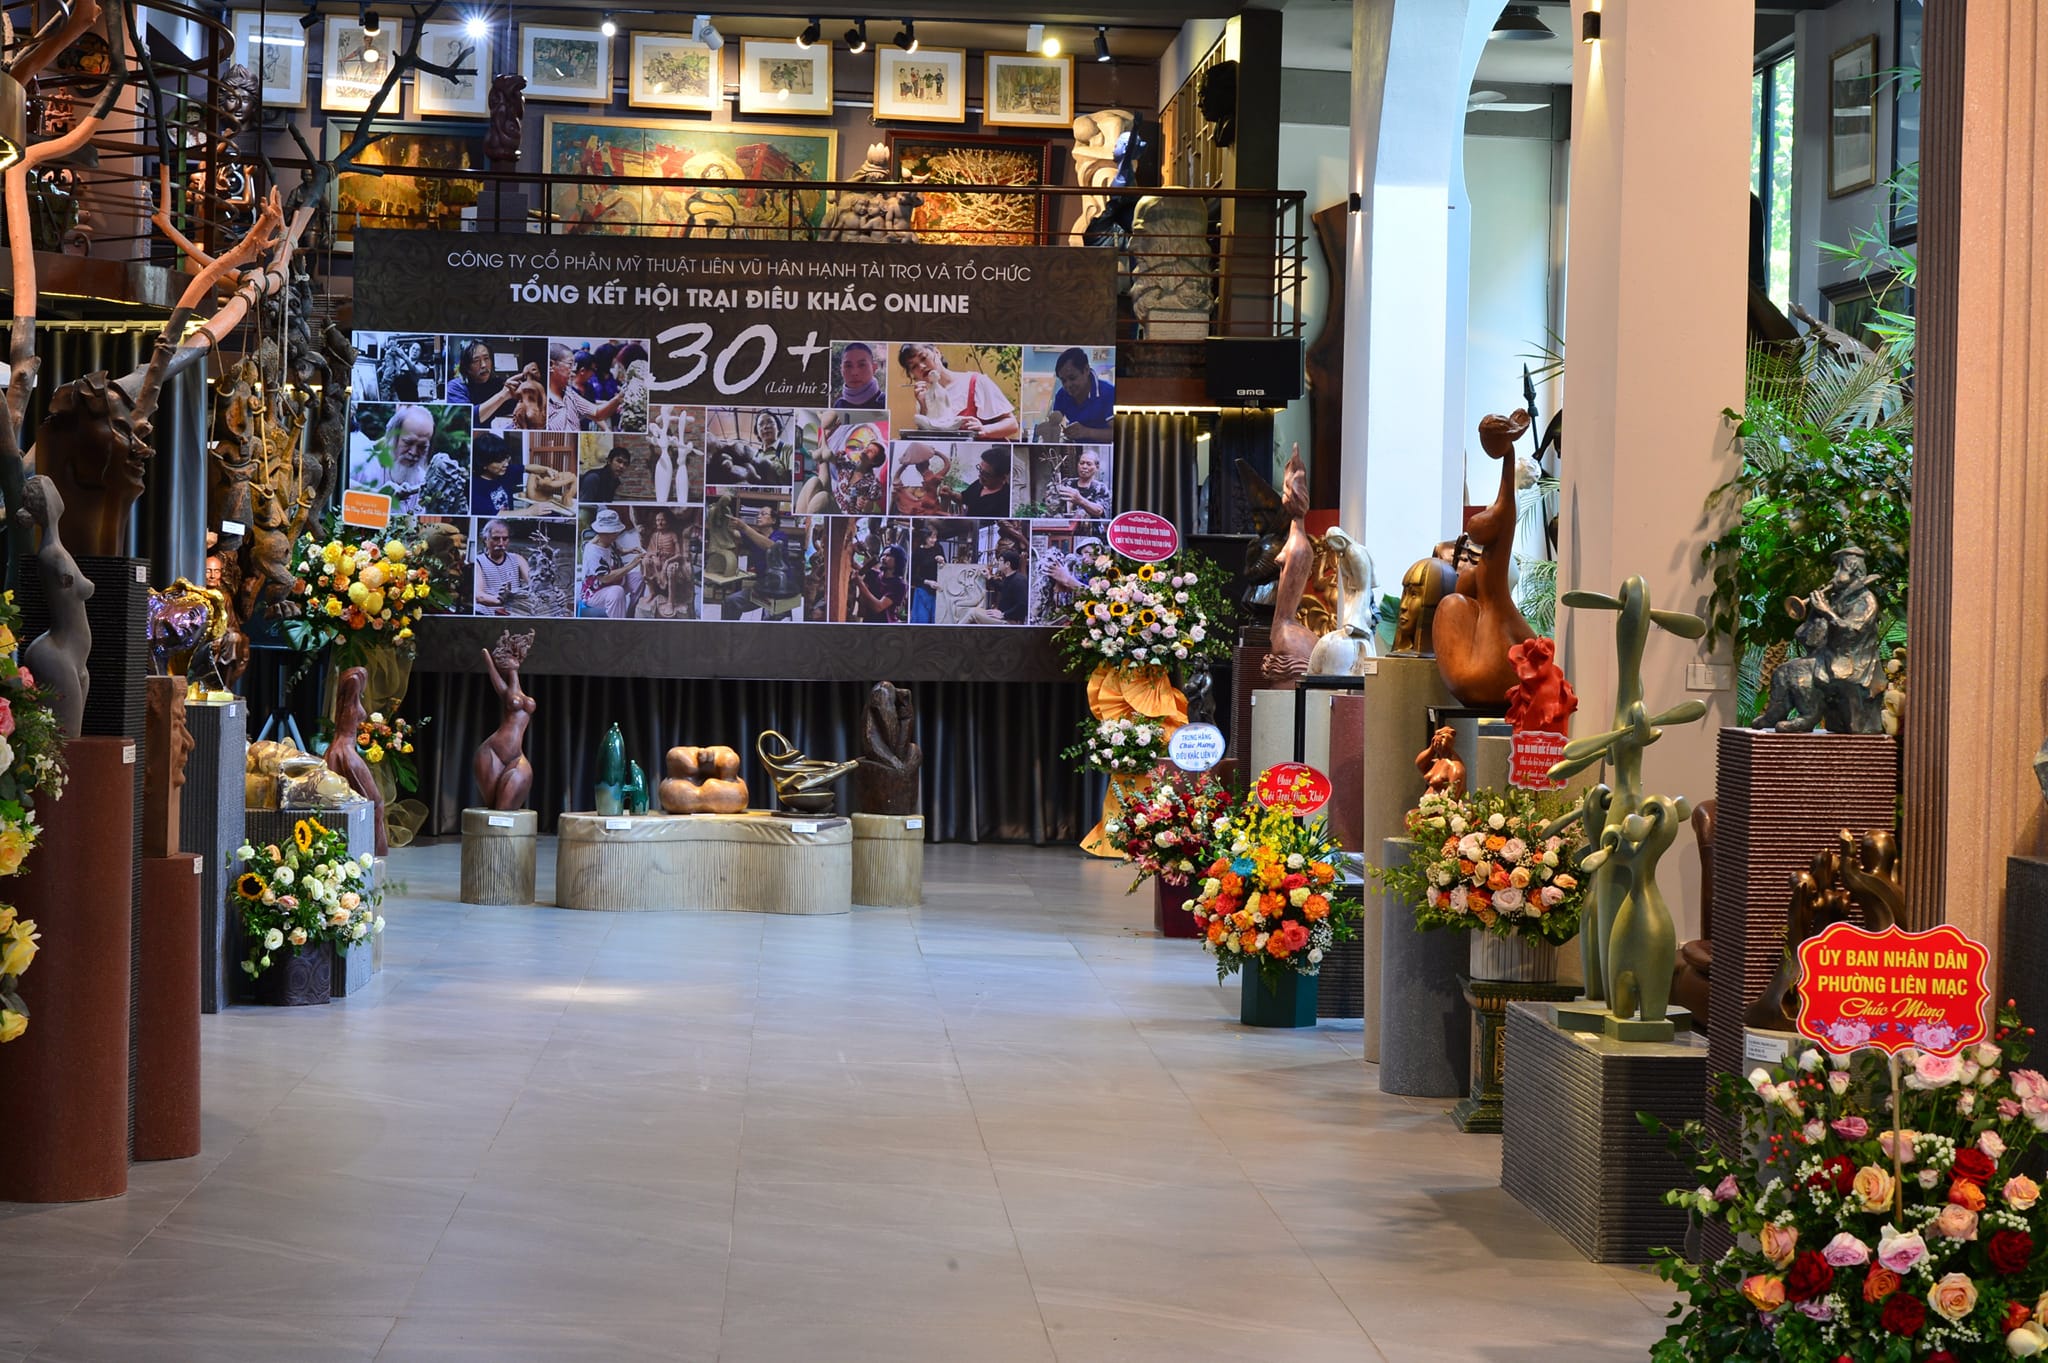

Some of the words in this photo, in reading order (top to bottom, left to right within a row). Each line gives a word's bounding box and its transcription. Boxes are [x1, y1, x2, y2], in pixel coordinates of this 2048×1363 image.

[447, 249, 504, 268] CÔNG
[508, 253, 527, 269] TY
[530, 248, 560, 270] CỔ
[564, 250, 612, 272] PHẦN
[616, 254, 643, 272] MỸ
[646, 255, 697, 275] THUẬT
[701, 255, 735, 275] LIÊN
[738, 257, 763, 276] VŨ
[767, 257, 804, 277] HÂN
[808, 261, 857, 280] HẠNH
[861, 260, 885, 279] TÀI
[889, 263, 922, 282] TRỢ
[926, 261, 951, 280] VÀ
[955, 259, 978, 282] TỔ
[981, 263, 1032, 282] CHỨC
[510, 273, 580, 304] TỔNG
[588, 278, 628, 306] KẾT
[635, 282, 679, 311] HỘI
[687, 288, 738, 313] TRẠI
[746, 284, 799, 311] ĐIÊU
[807, 283, 877, 312] KHẮC
[884, 292, 969, 314] ONLINE
[764, 380, 794, 395] (Lần
[796, 381, 819, 395] thứ
[1818, 945, 1842, 966] ỦY
[1846, 950, 1879, 968] BAN
[1883, 948, 1929, 969] NHÂN
[1934, 949, 1968, 970] DÂN
[1817, 972, 1887, 994] PHƯỜNG
[1890, 974, 1927, 995] LIÊN
[1931, 978, 1968, 999] MẠC
[1839, 997, 1889, 1018] Chúc
[1890, 997, 1946, 1025] Mừng
